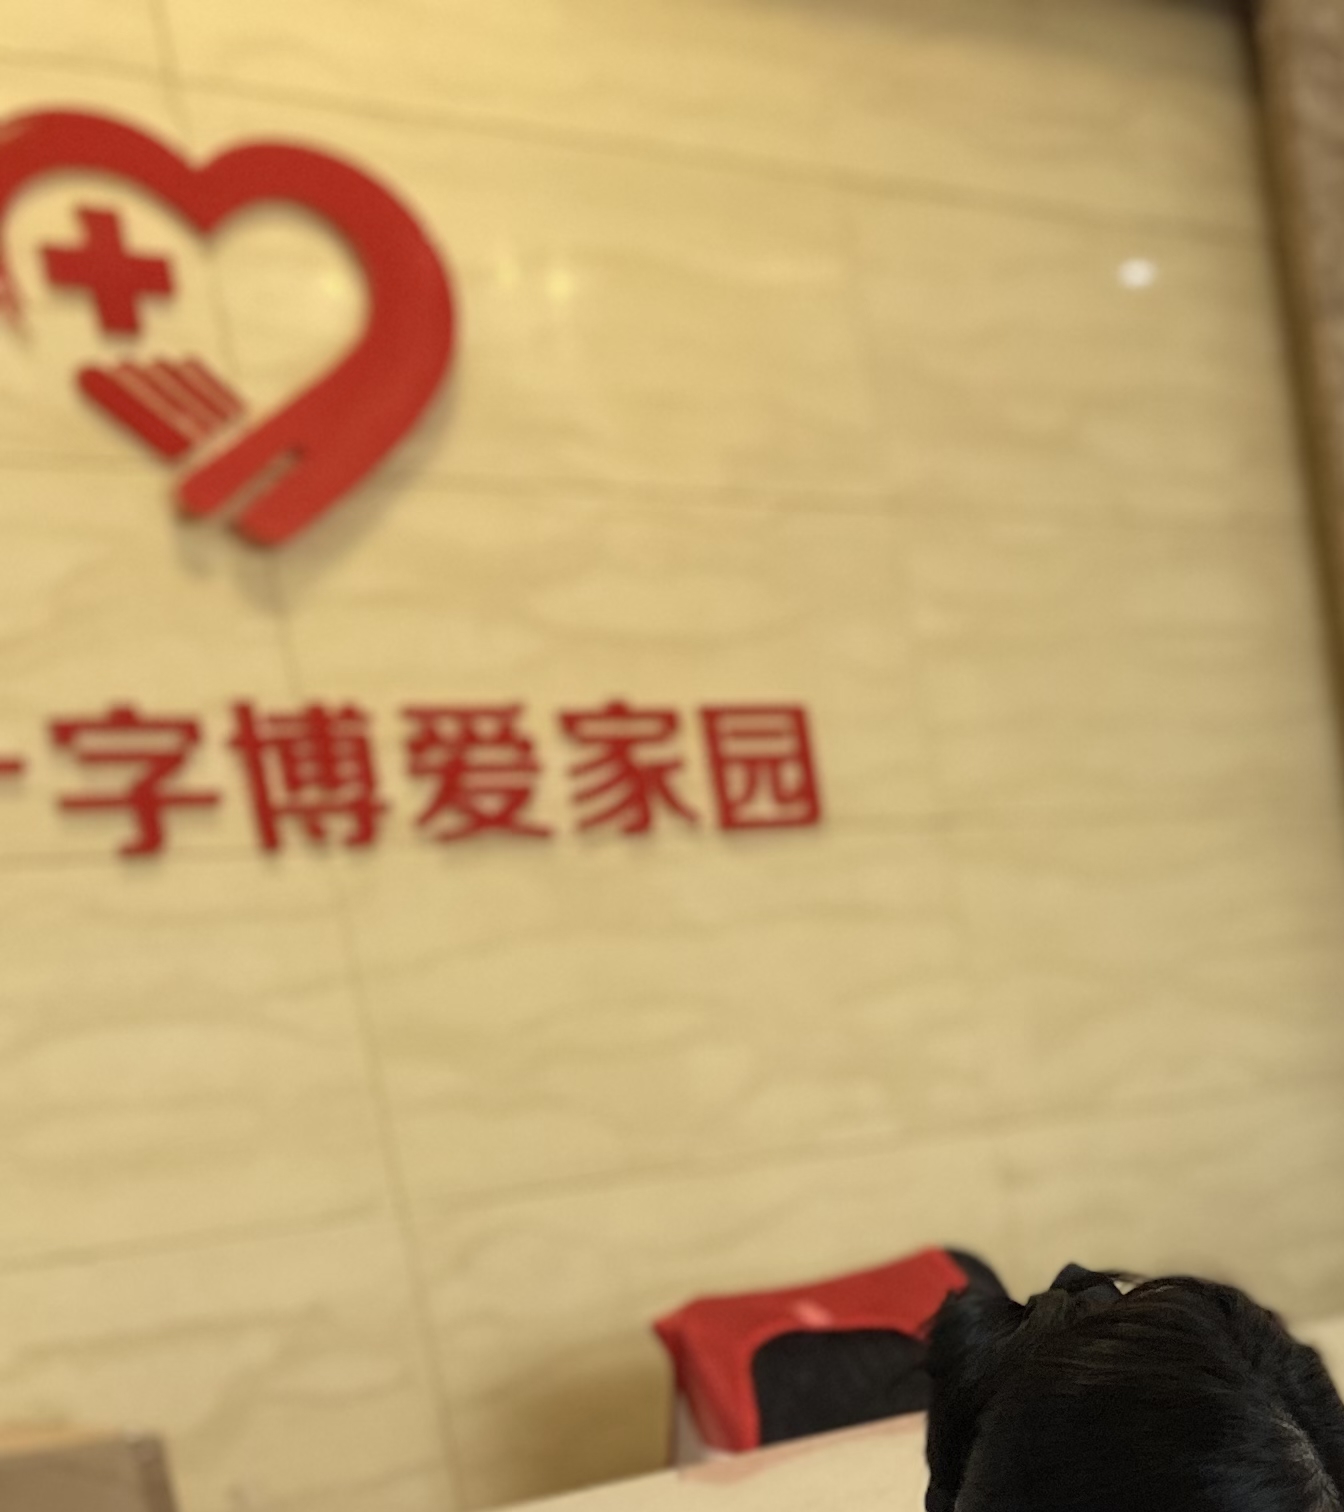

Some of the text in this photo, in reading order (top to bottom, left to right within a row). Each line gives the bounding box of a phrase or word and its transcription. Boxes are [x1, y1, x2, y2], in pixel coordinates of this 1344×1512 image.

[0, 698, 826, 860] 字博爱家园
